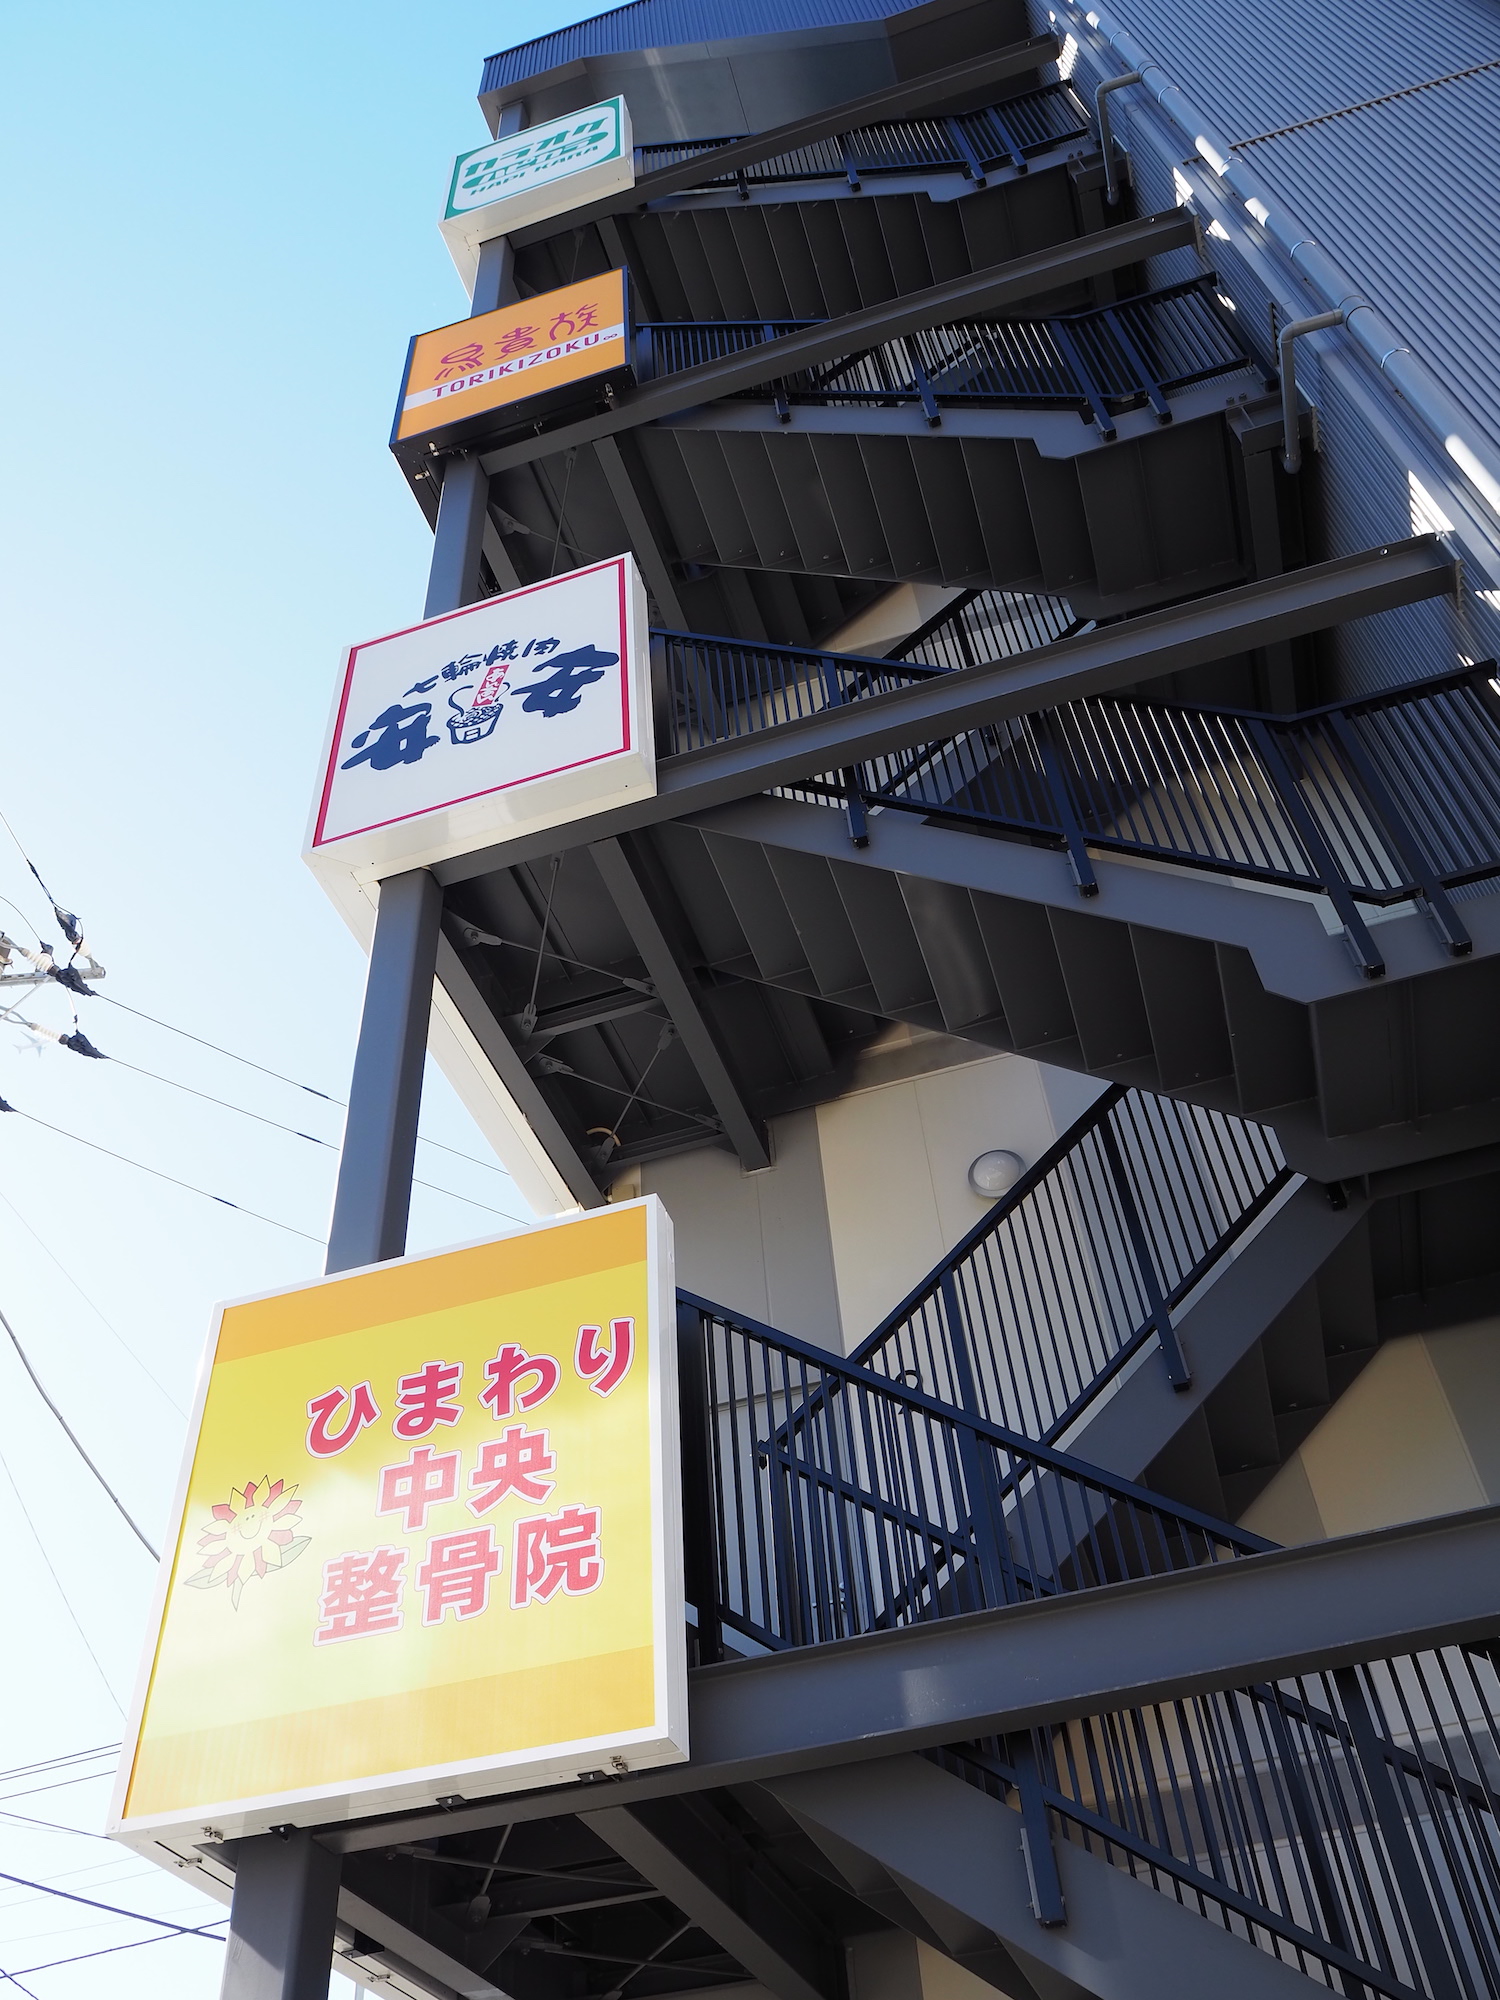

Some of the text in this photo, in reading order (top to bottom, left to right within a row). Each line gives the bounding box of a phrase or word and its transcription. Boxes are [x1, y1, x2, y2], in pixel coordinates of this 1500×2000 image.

[432, 333, 600, 397] TORIKIZOKU
[434, 303, 599, 380] 鳥貴族
[402, 637, 561, 698] 七輪焼肉
[305, 1317, 636, 1459] ひまわり
[376, 1423, 557, 1533] 中央
[312, 1503, 605, 1647] 整骨院
